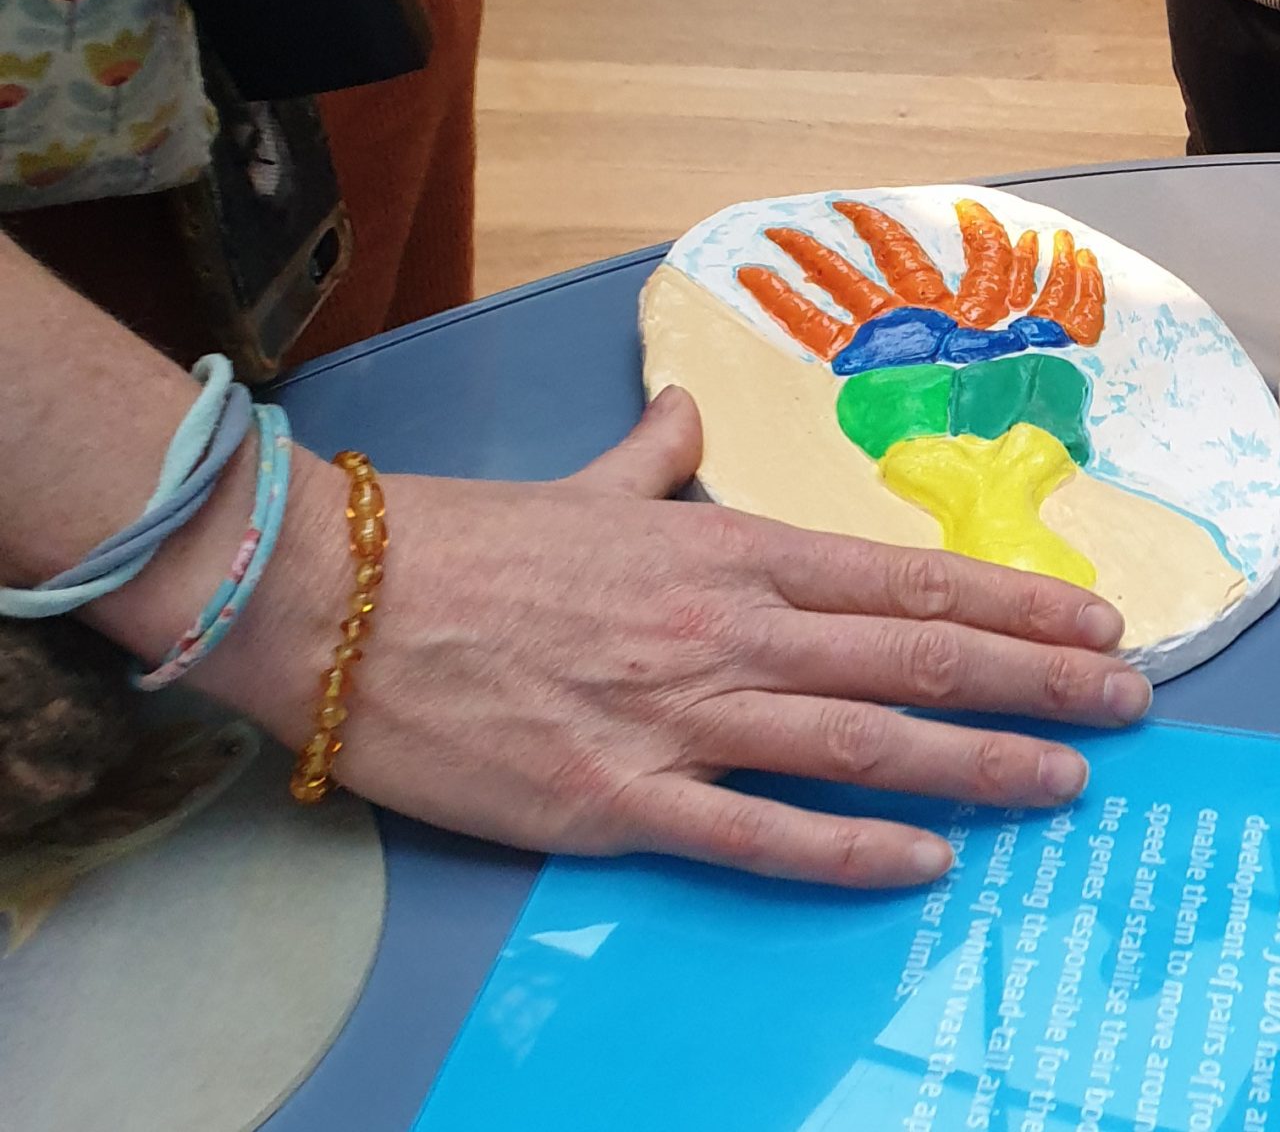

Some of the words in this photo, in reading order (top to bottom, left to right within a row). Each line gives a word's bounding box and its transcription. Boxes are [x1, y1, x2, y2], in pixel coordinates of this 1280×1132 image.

[1099, 796, 1128, 832] the
[1140, 802, 1171, 865] speed
[1186, 808, 1218, 880] enable
[984, 824, 1020, 887] result
[1022, 846, 1066, 908] along
[1081, 834, 1115, 899] genes
[969, 890, 1002, 918] of
[1129, 865, 1157, 912] and
[1173, 884, 1208, 945] them
[1221, 814, 1270, 960] development
[952, 918, 992, 991] which
[1016, 914, 1048, 953] the
[1167, 950, 1193, 976] to
[1045, 903, 1098, 1042] responsible
[1105, 914, 1147, 1015] stabilise
[1209, 962, 1243, 994] of
[935, 996, 969, 1047] was
[984, 957, 1039, 1071] head-tail
[1151, 979, 1184, 1049] move
[1203, 991, 1236, 1056] pairs
[919, 1053, 956, 1098] the
[1034, 1046, 1070, 1085] for
[1090, 1020, 1127, 1085] their
[1189, 1059, 1226, 1092] of
[967, 1074, 1000, 1128] axis
[1020, 1088, 1057, 1132] the
[1187, 1091, 1225, 1132] fro
